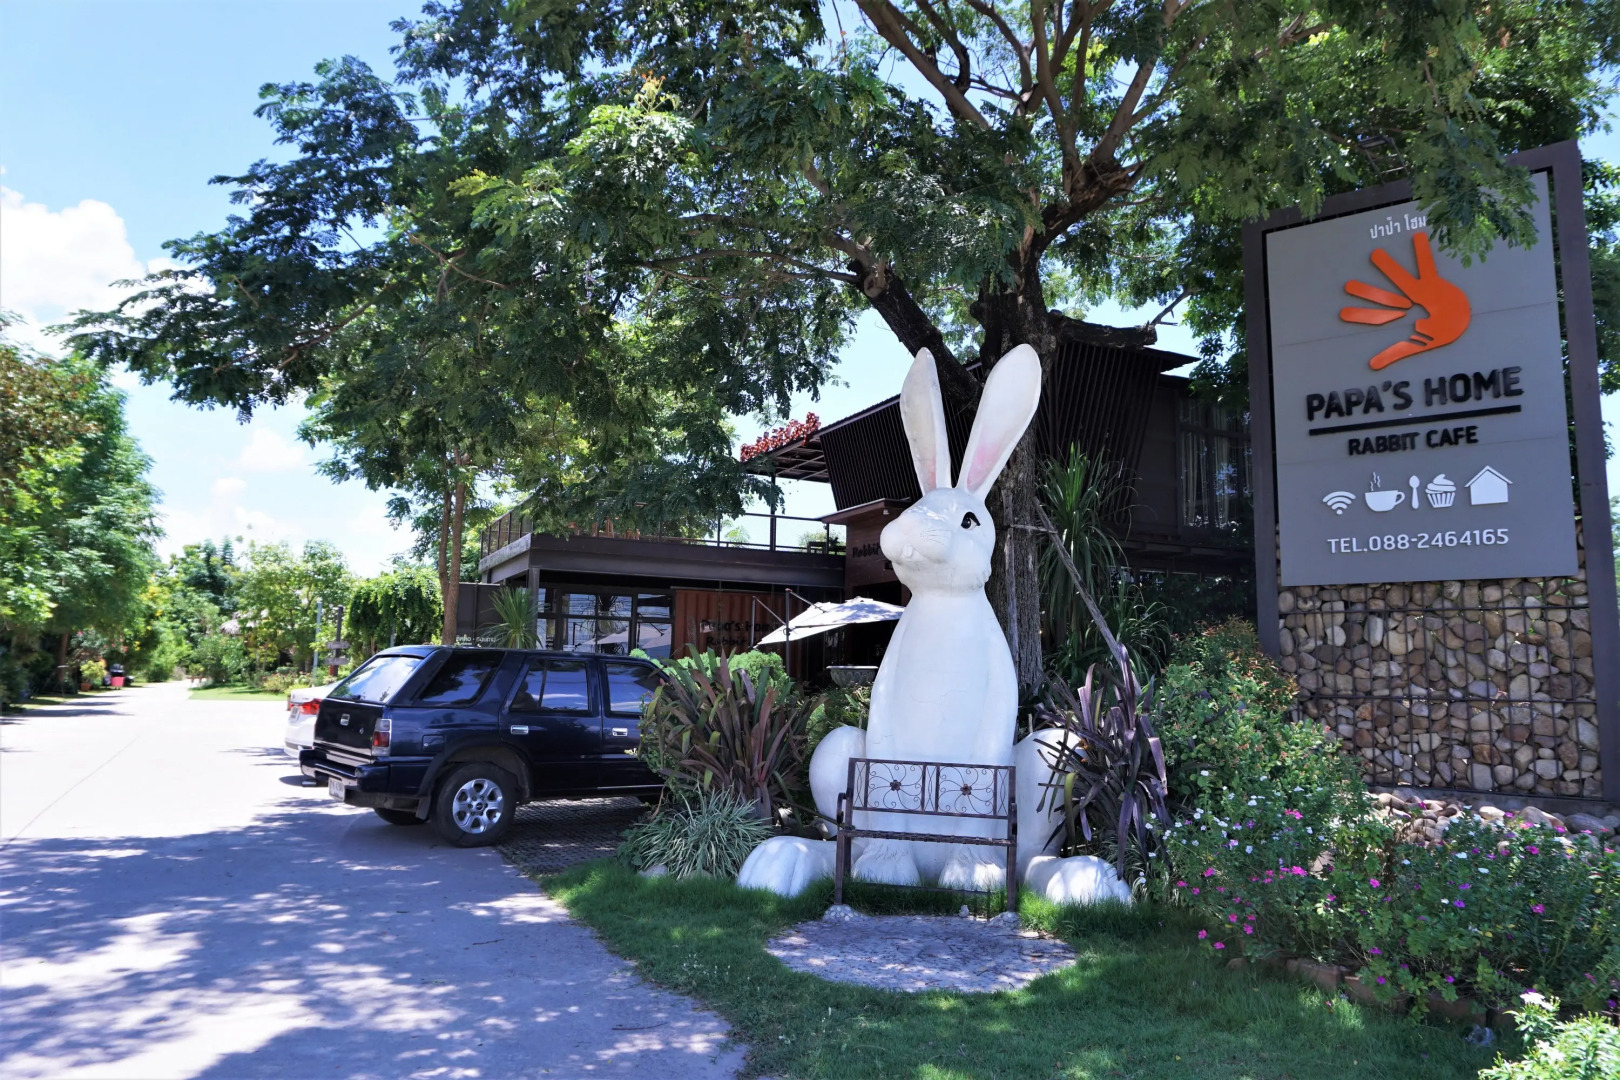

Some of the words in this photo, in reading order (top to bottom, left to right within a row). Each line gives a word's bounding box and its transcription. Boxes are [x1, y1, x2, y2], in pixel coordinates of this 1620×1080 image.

[1306, 380, 1414, 421] PAPA'S
[1424, 366, 1524, 406] HOME
[1348, 431, 1420, 456] RABBIT
[1426, 425, 1479, 449] CAFE
[1327, 528, 1510, 554] TEL.088-2464165
